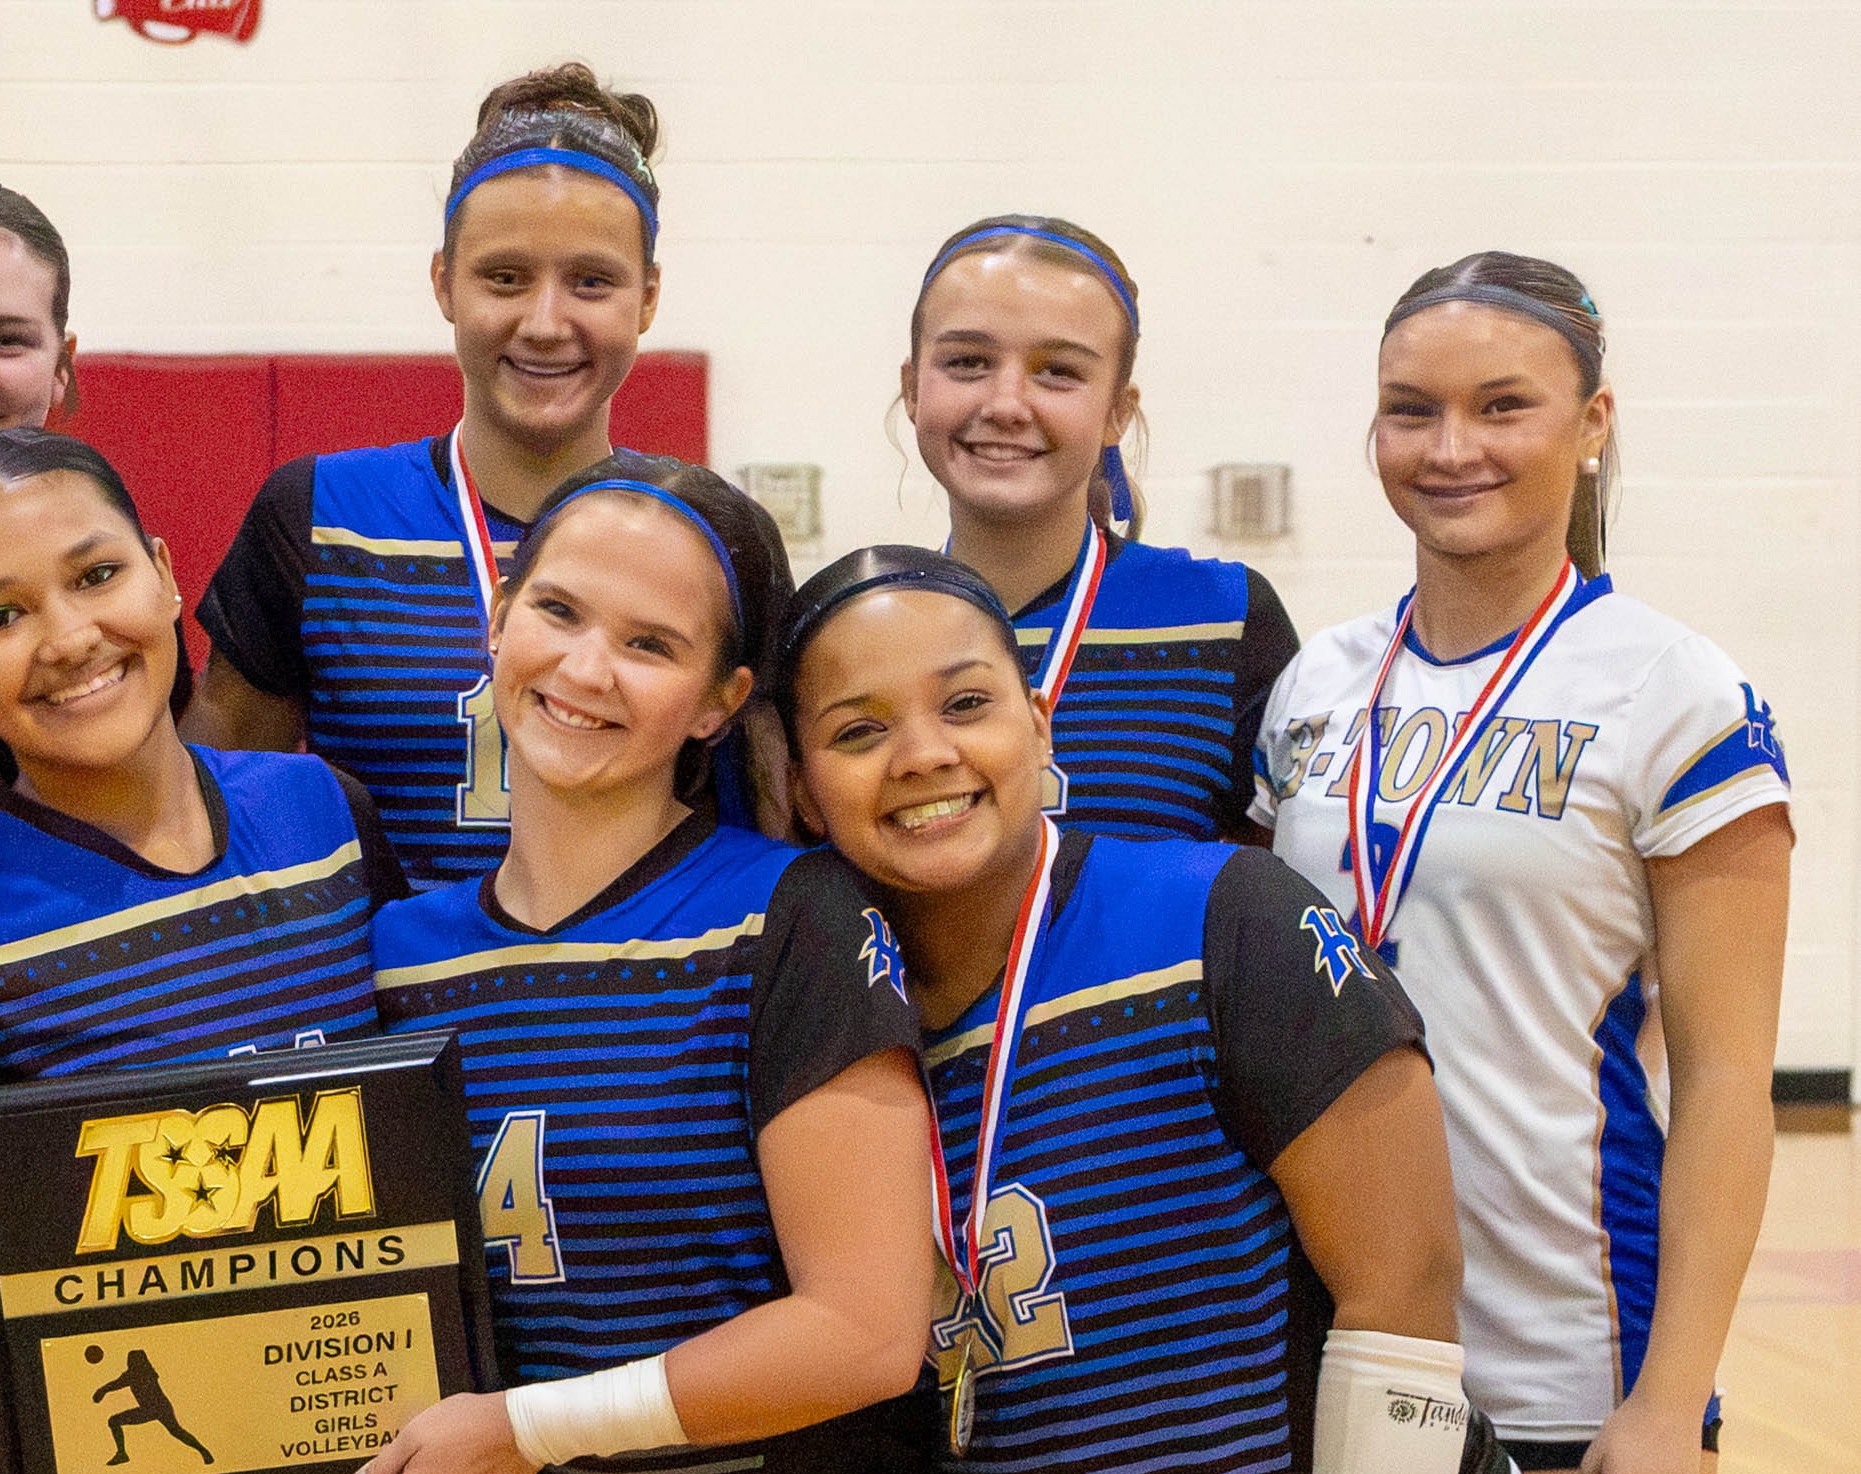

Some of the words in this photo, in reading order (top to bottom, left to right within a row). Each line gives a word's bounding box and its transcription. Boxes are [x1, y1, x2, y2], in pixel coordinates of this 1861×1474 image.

[74, 1085, 377, 1256] TSSAA
[53, 1234, 407, 1306] CHAMPIONS
[310, 1311, 361, 1331] 2026
[263, 1330, 396, 1366] DIVISION
[405, 1328, 413, 1349] I
[295, 1364, 368, 1387] CLASS
[372, 1361, 388, 1378] A
[290, 1384, 399, 1413] DISTRICT
[314, 1412, 378, 1434] GIRLS
[280, 1429, 400, 1458] VOLLEYBA
